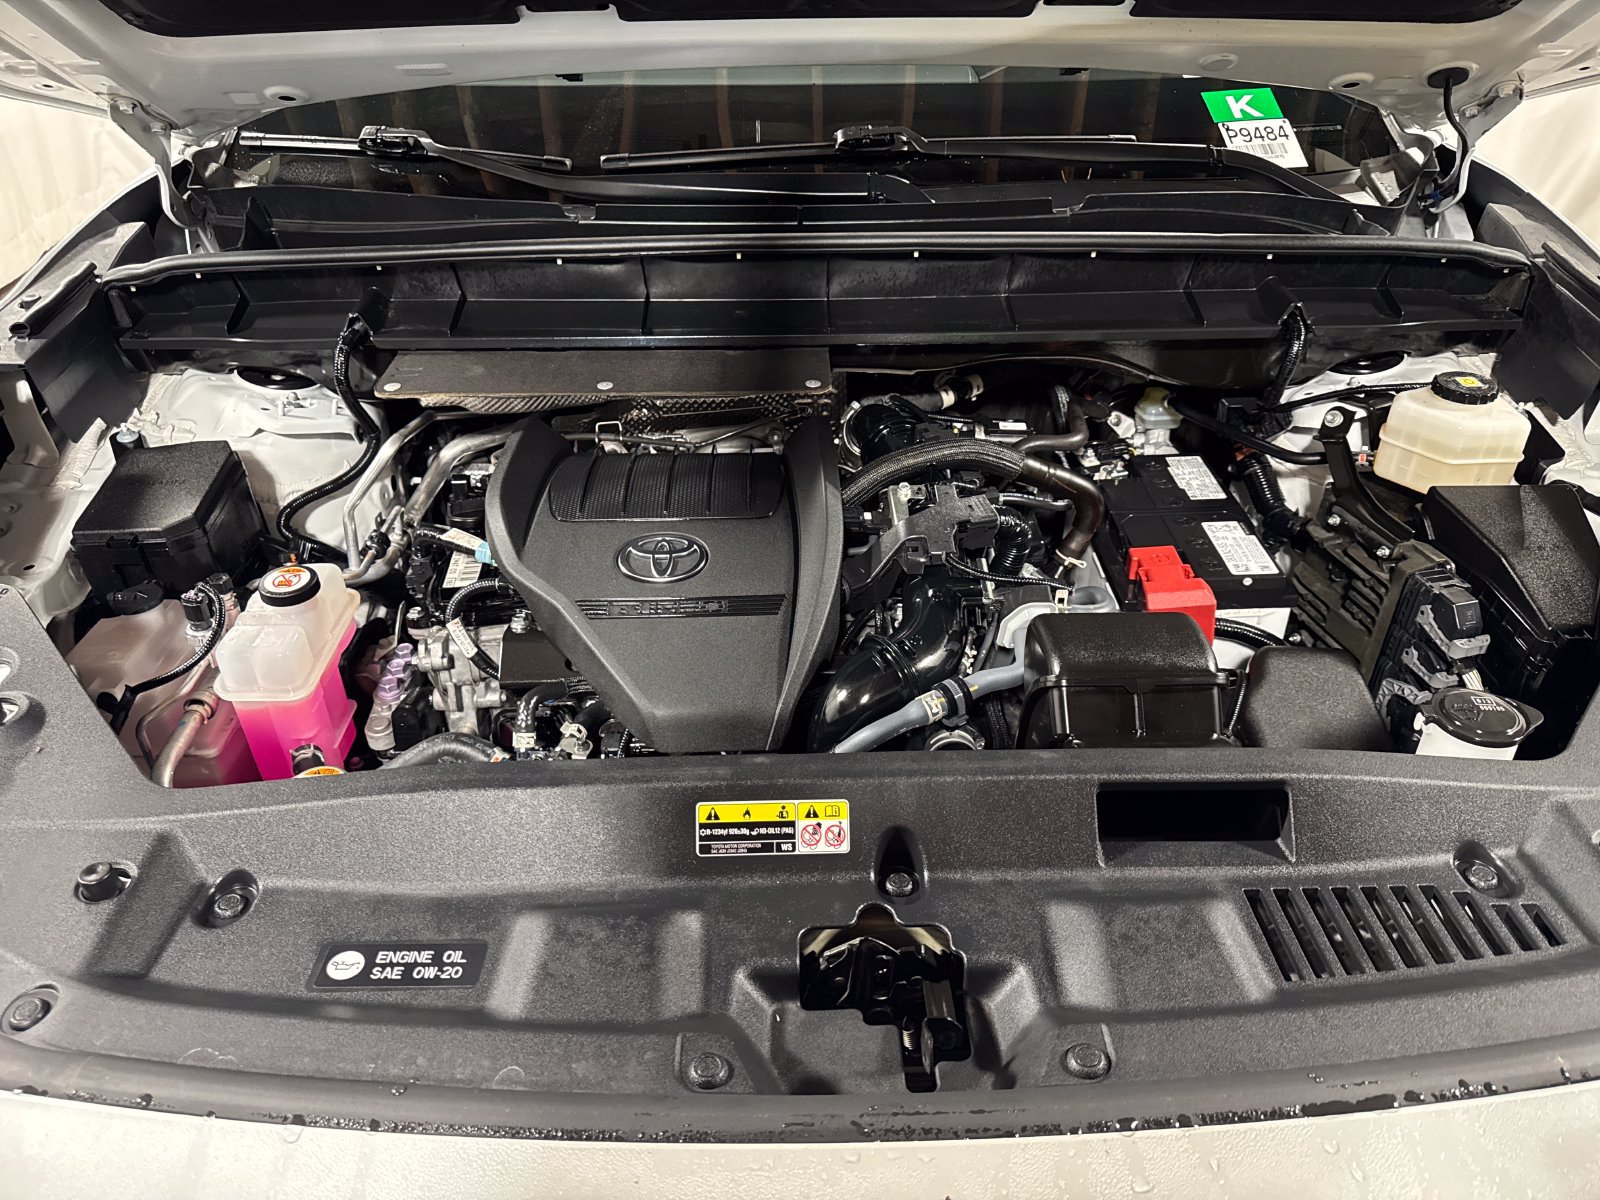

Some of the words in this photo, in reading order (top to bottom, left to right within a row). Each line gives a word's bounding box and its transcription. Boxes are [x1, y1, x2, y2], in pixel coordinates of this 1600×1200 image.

[1224, 94, 1265, 119] K
[1227, 125, 1290, 144] P9484
[781, 843, 793, 851] WS
[375, 950, 435, 964] ENGINE
[442, 950, 467, 963] OIL
[369, 966, 405, 980] SAE
[412, 966, 463, 979] 0W-20
